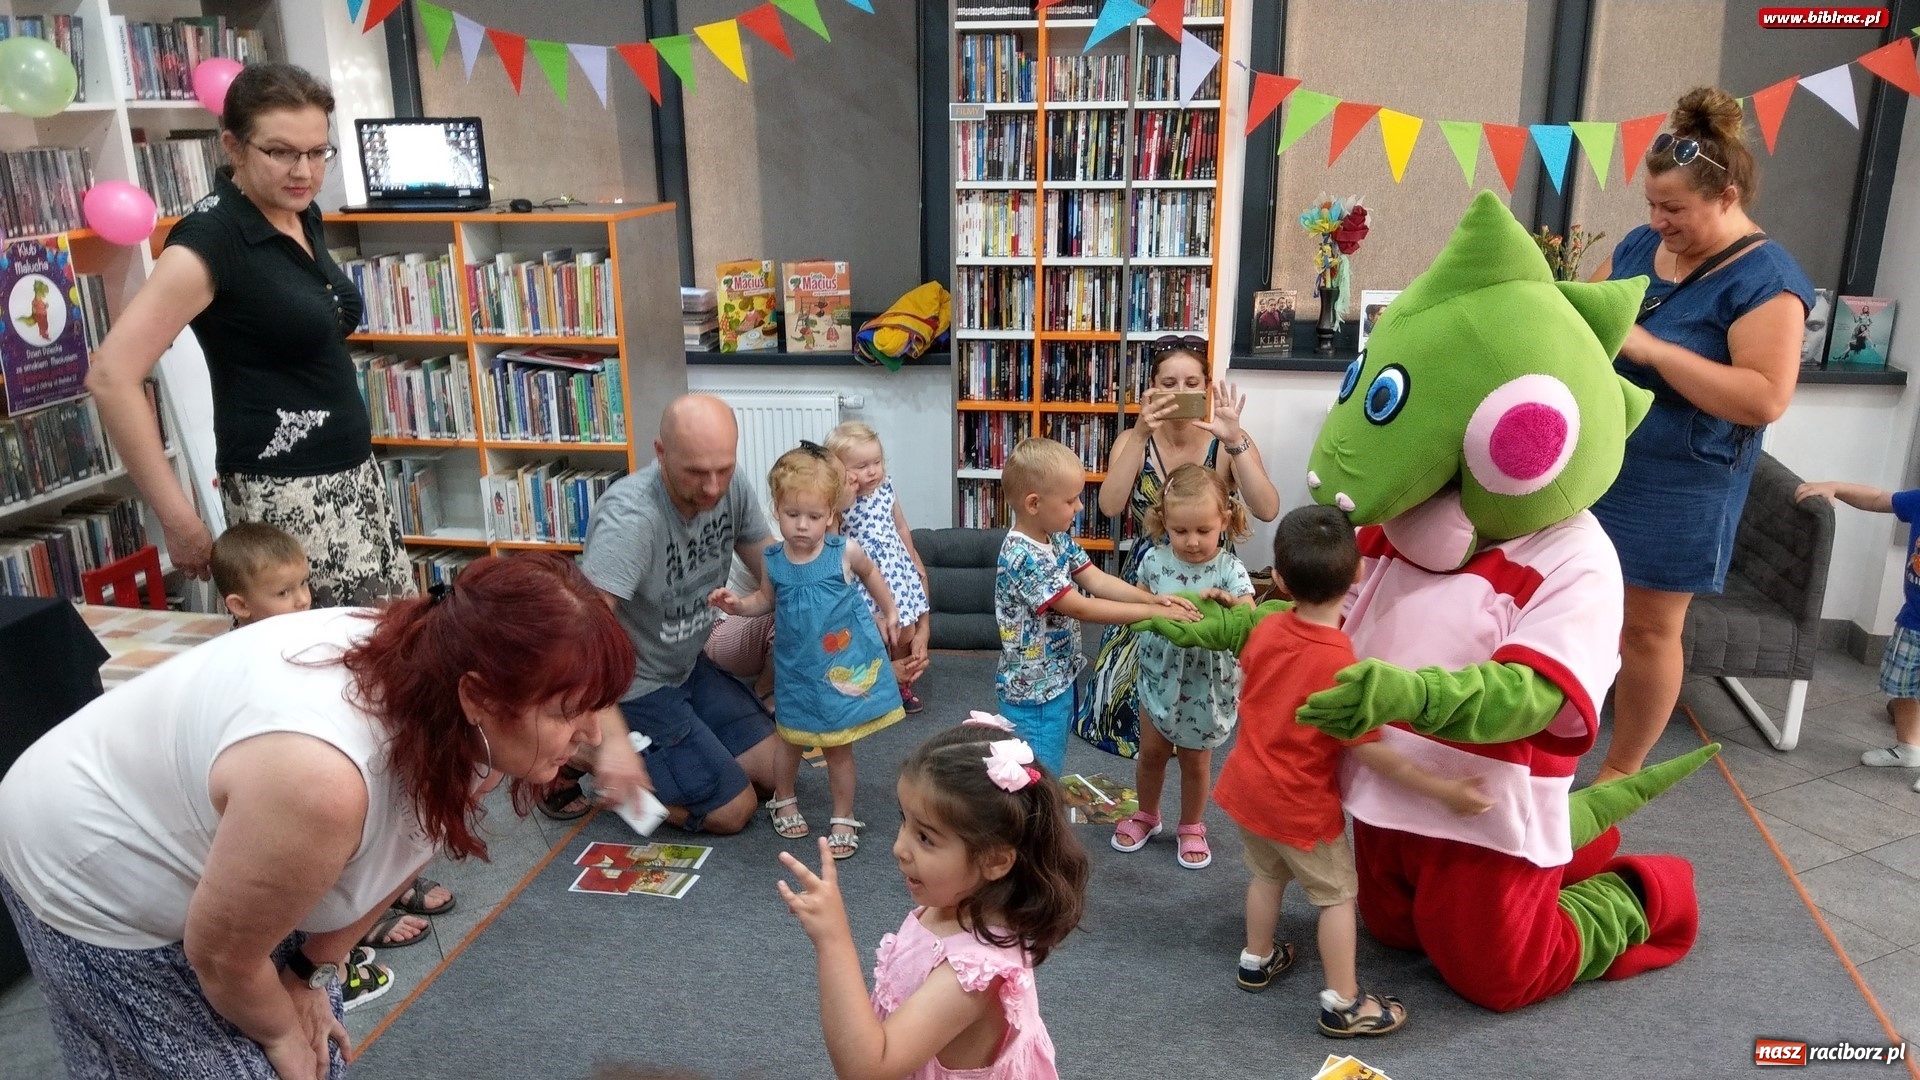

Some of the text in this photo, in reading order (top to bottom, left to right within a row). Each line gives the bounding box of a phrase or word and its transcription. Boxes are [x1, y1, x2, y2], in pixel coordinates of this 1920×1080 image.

[955, 106, 979, 116] FILMY
[17, 243, 37, 258] Klub
[14, 258, 49, 275] Malucha
[734, 274, 765, 290] Maciuś
[802, 274, 837, 290] Maciuś
[1259, 335, 1286, 345] KLER
